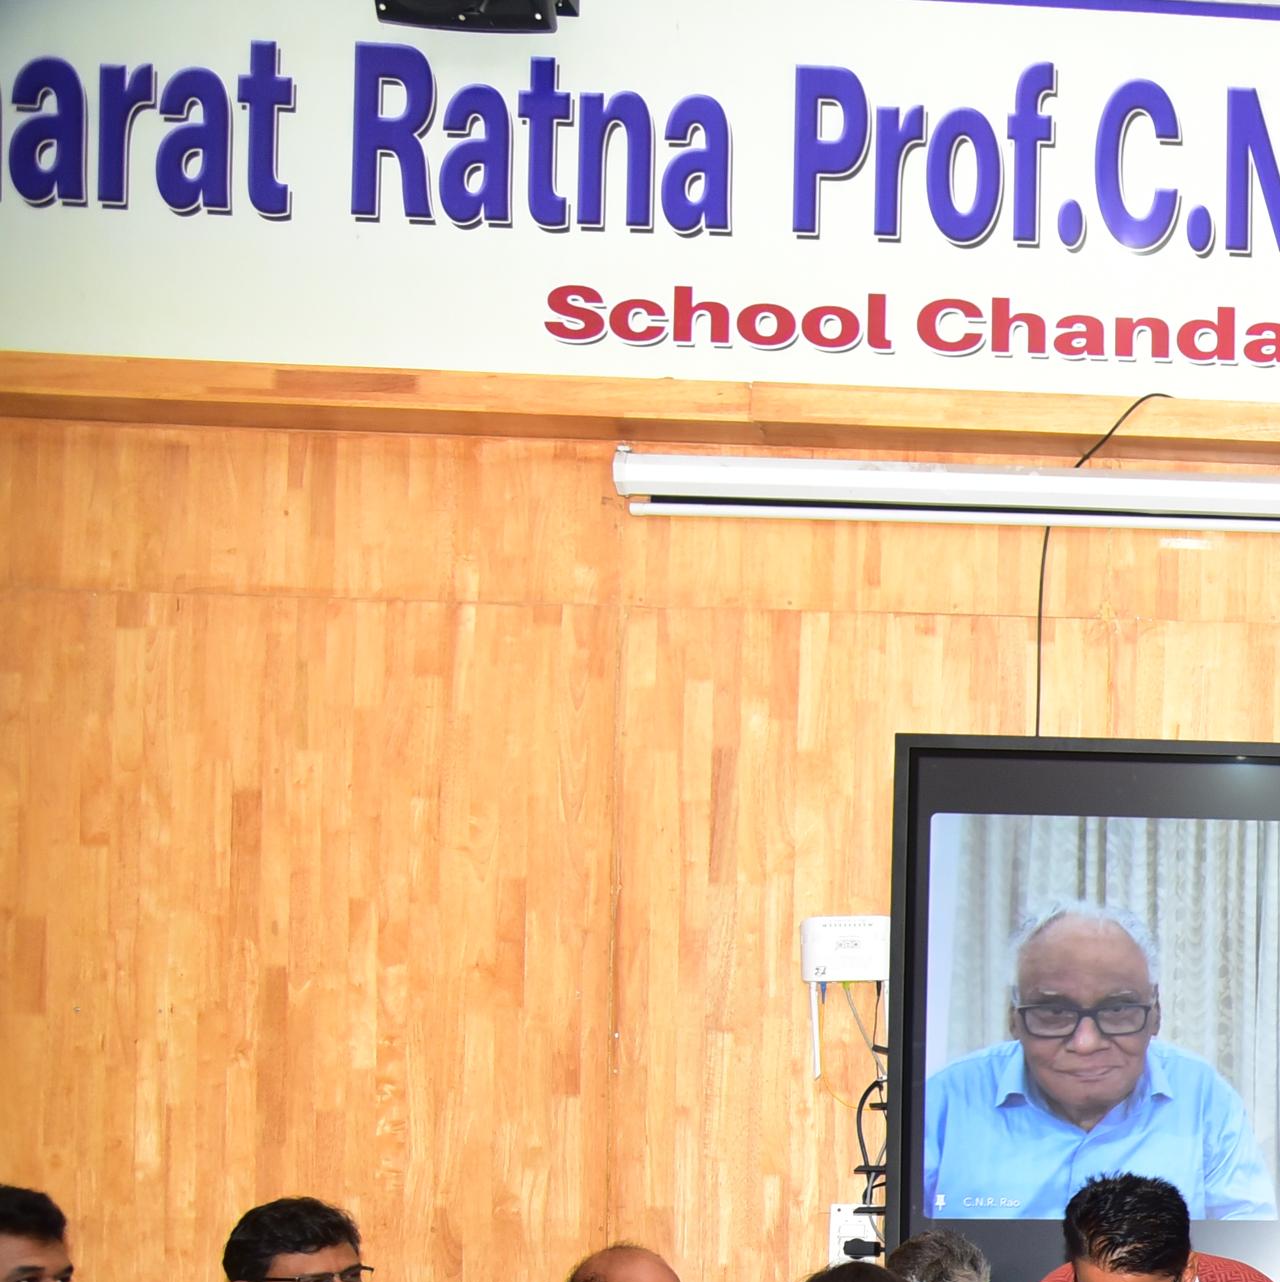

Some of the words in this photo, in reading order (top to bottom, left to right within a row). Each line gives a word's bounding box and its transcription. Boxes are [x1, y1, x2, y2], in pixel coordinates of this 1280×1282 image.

[0, 43, 293, 215] arat
[352, 44, 731, 233] Ratna
[545, 285, 892, 350] School
[963, 1197, 996, 1208] C.N.R.
[1000, 1198, 1020, 1208] Rao
